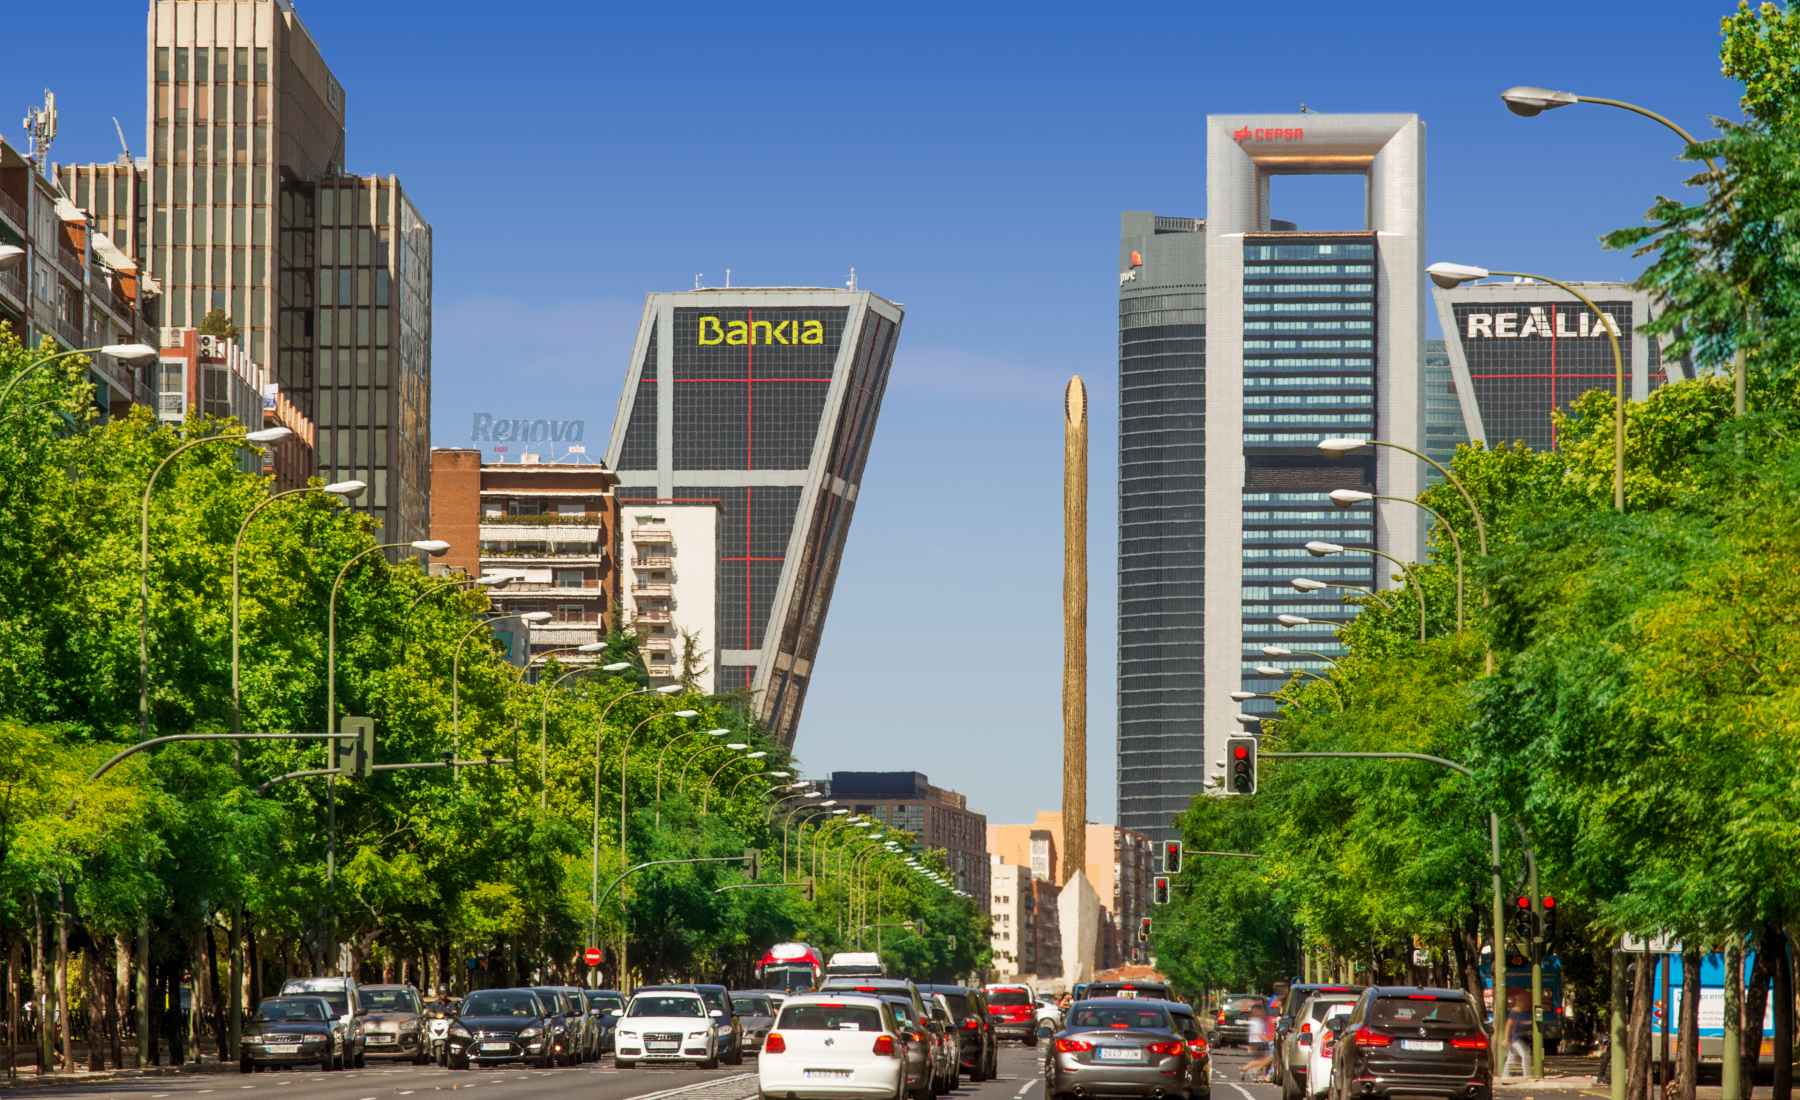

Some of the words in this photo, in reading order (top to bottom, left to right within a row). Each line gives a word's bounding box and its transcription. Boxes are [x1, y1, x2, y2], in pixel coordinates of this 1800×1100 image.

[1255, 128, 1304, 142] CEPSA
[698, 315, 824, 345] Bankia
[1467, 306, 1622, 338] REALIA
[472, 412, 585, 442] Renova
